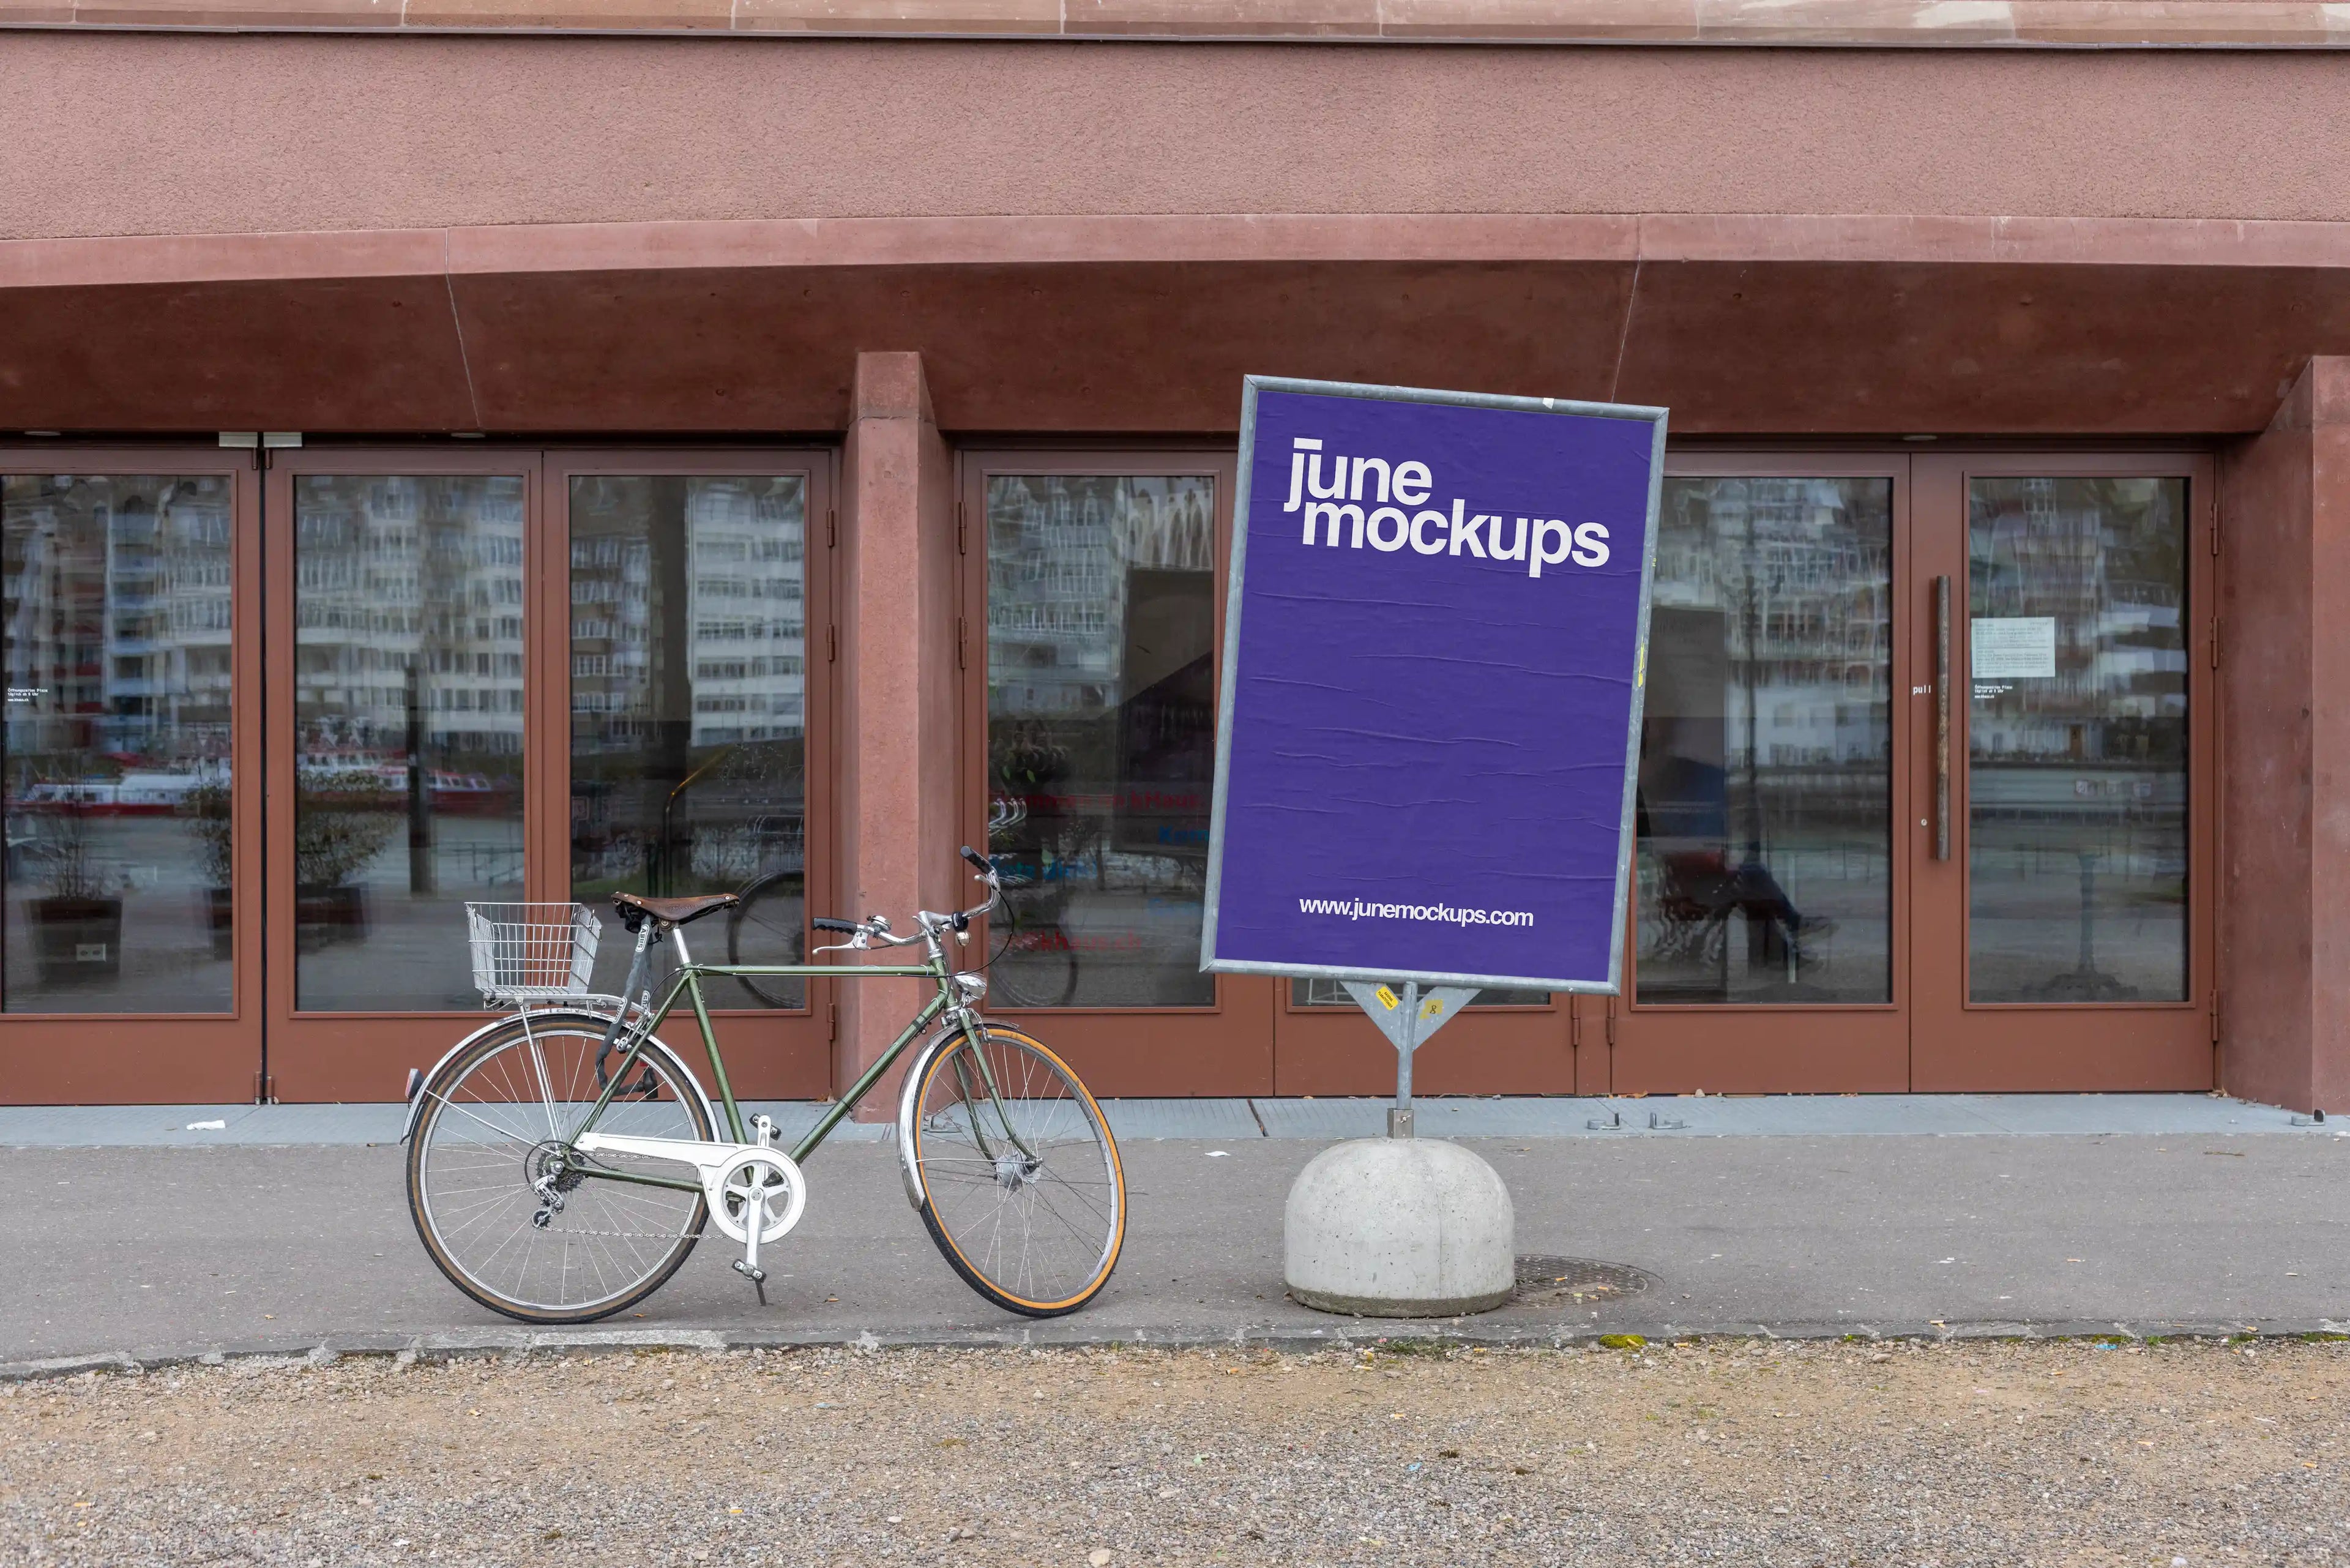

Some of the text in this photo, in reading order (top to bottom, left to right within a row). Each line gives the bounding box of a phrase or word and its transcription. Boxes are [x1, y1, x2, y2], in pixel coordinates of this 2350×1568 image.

[1283, 437, 1433, 512] june
[1302, 498, 1610, 578] mockups
[1913, 685, 1931, 695] pull
[1299, 897, 1534, 927] www.junemockups.com
